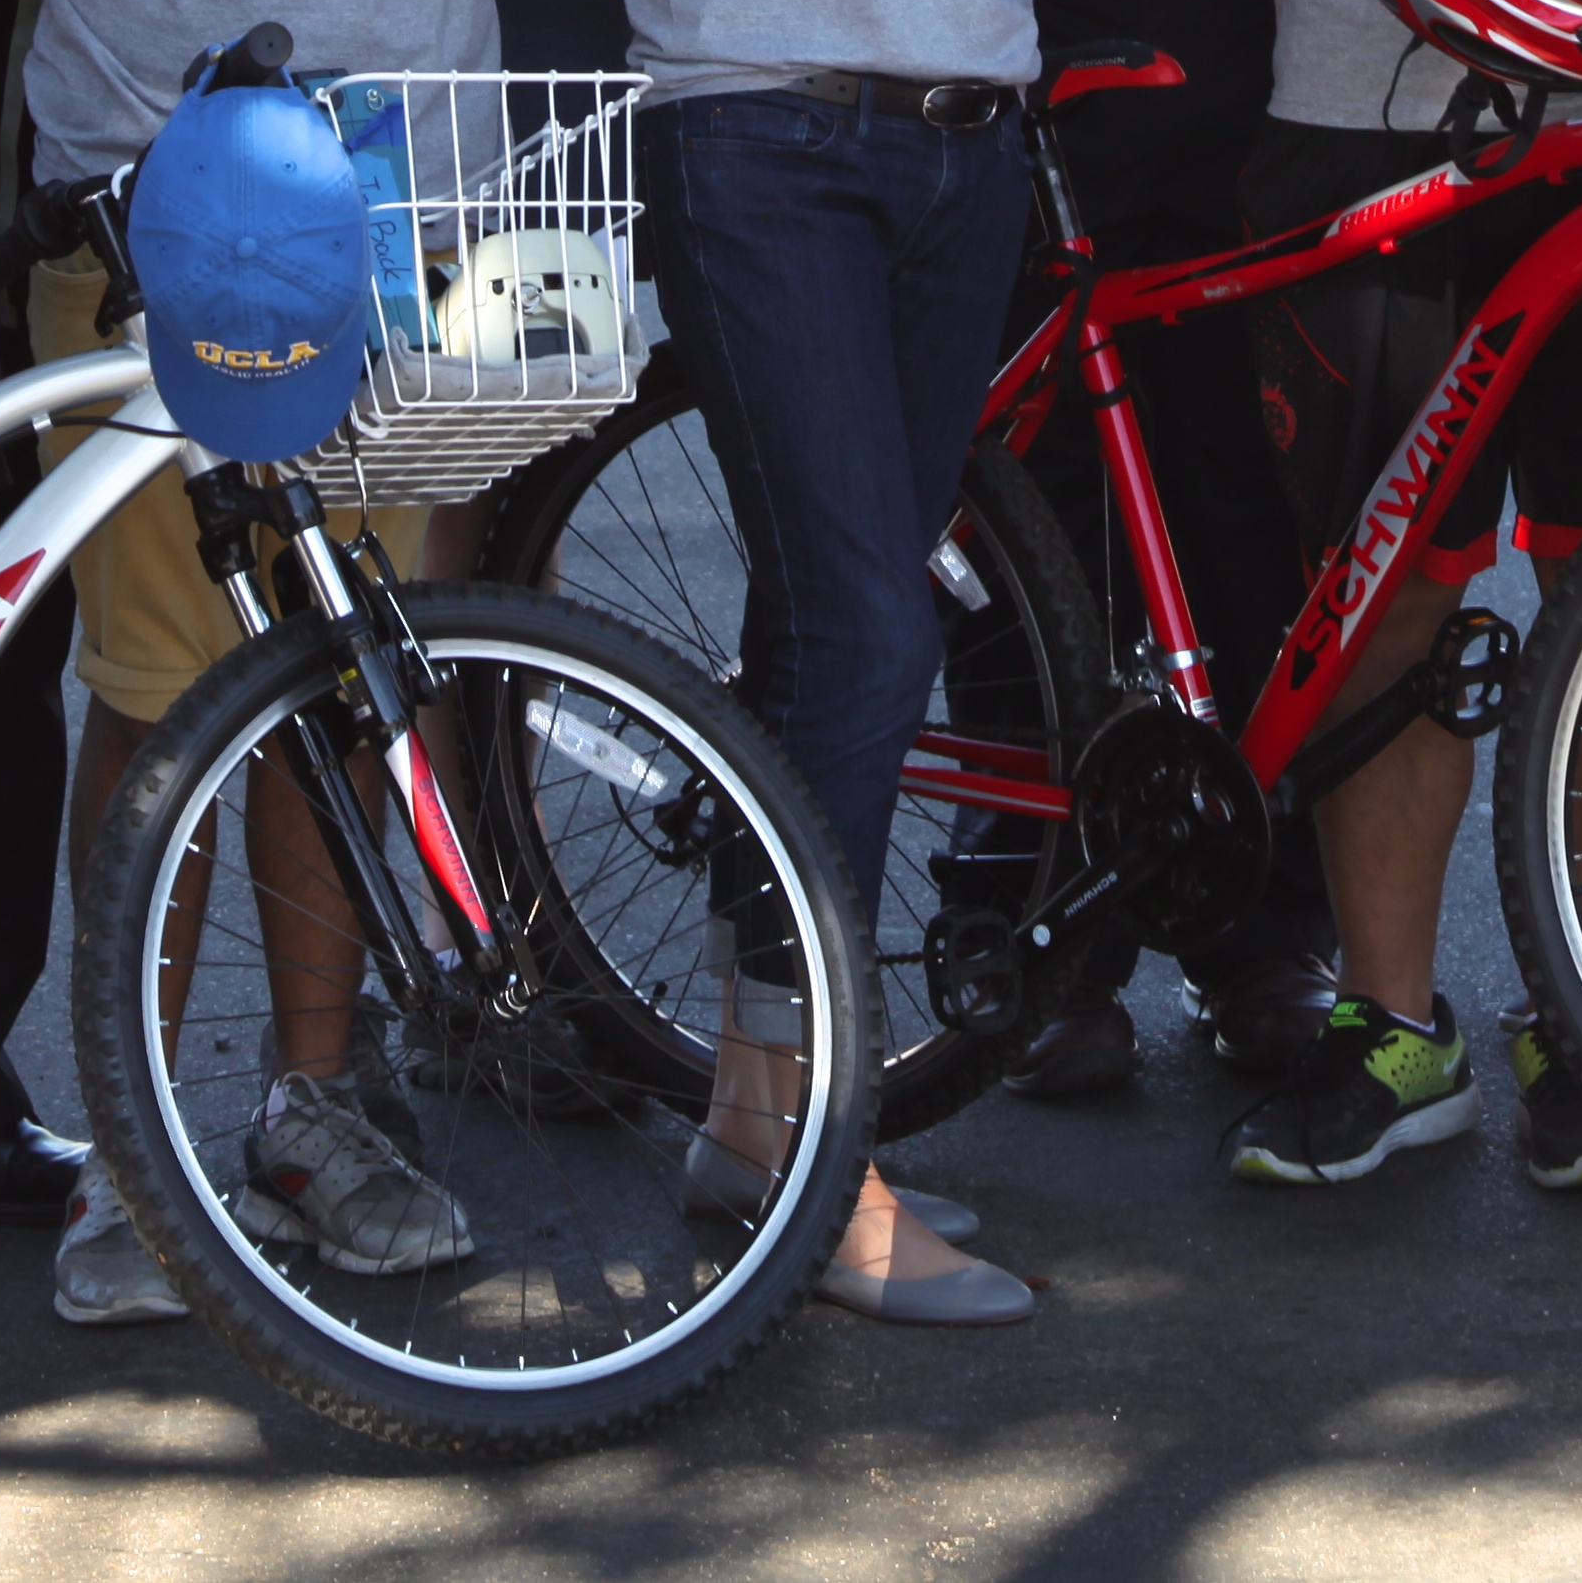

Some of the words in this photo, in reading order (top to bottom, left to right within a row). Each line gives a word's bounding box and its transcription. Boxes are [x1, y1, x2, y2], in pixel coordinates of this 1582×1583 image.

[1068, 56, 1126, 69] SCHWINN
[370, 220, 412, 285] Back
[192, 340, 320, 369] UCLA
[1301, 332, 1506, 661] SCHWINN
[417, 776, 477, 905] SCHWINN
[1064, 871, 1118, 918] SCHWINN
